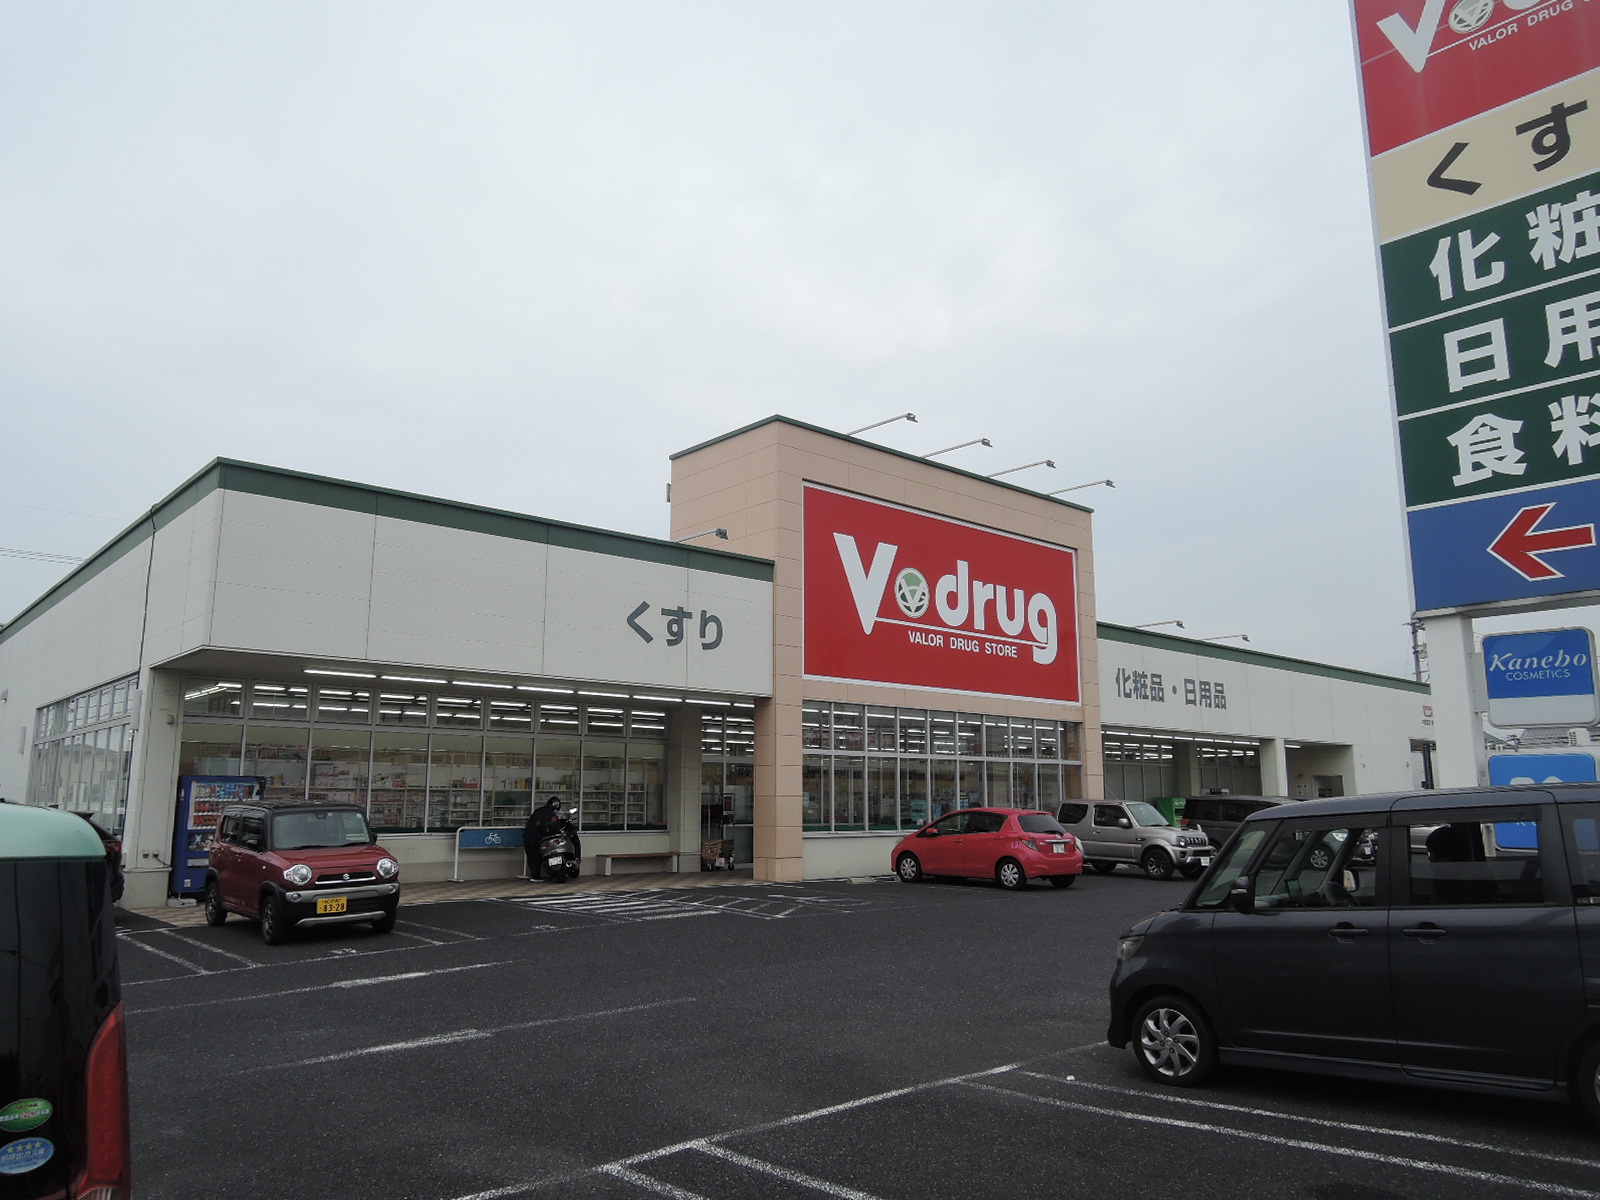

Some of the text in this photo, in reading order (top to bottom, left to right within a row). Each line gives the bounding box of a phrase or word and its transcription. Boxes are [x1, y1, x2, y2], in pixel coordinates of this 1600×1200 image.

[1468, 0, 1574, 51] VALOR DRUG
[1427, 99, 1589, 196] くす
[626, 600, 724, 650] くすり
[908, 630, 1018, 658] VALOR DRUG STORE
[1489, 649, 1587, 672] Kanebo
[1505, 668, 1571, 682] COSMETICS
